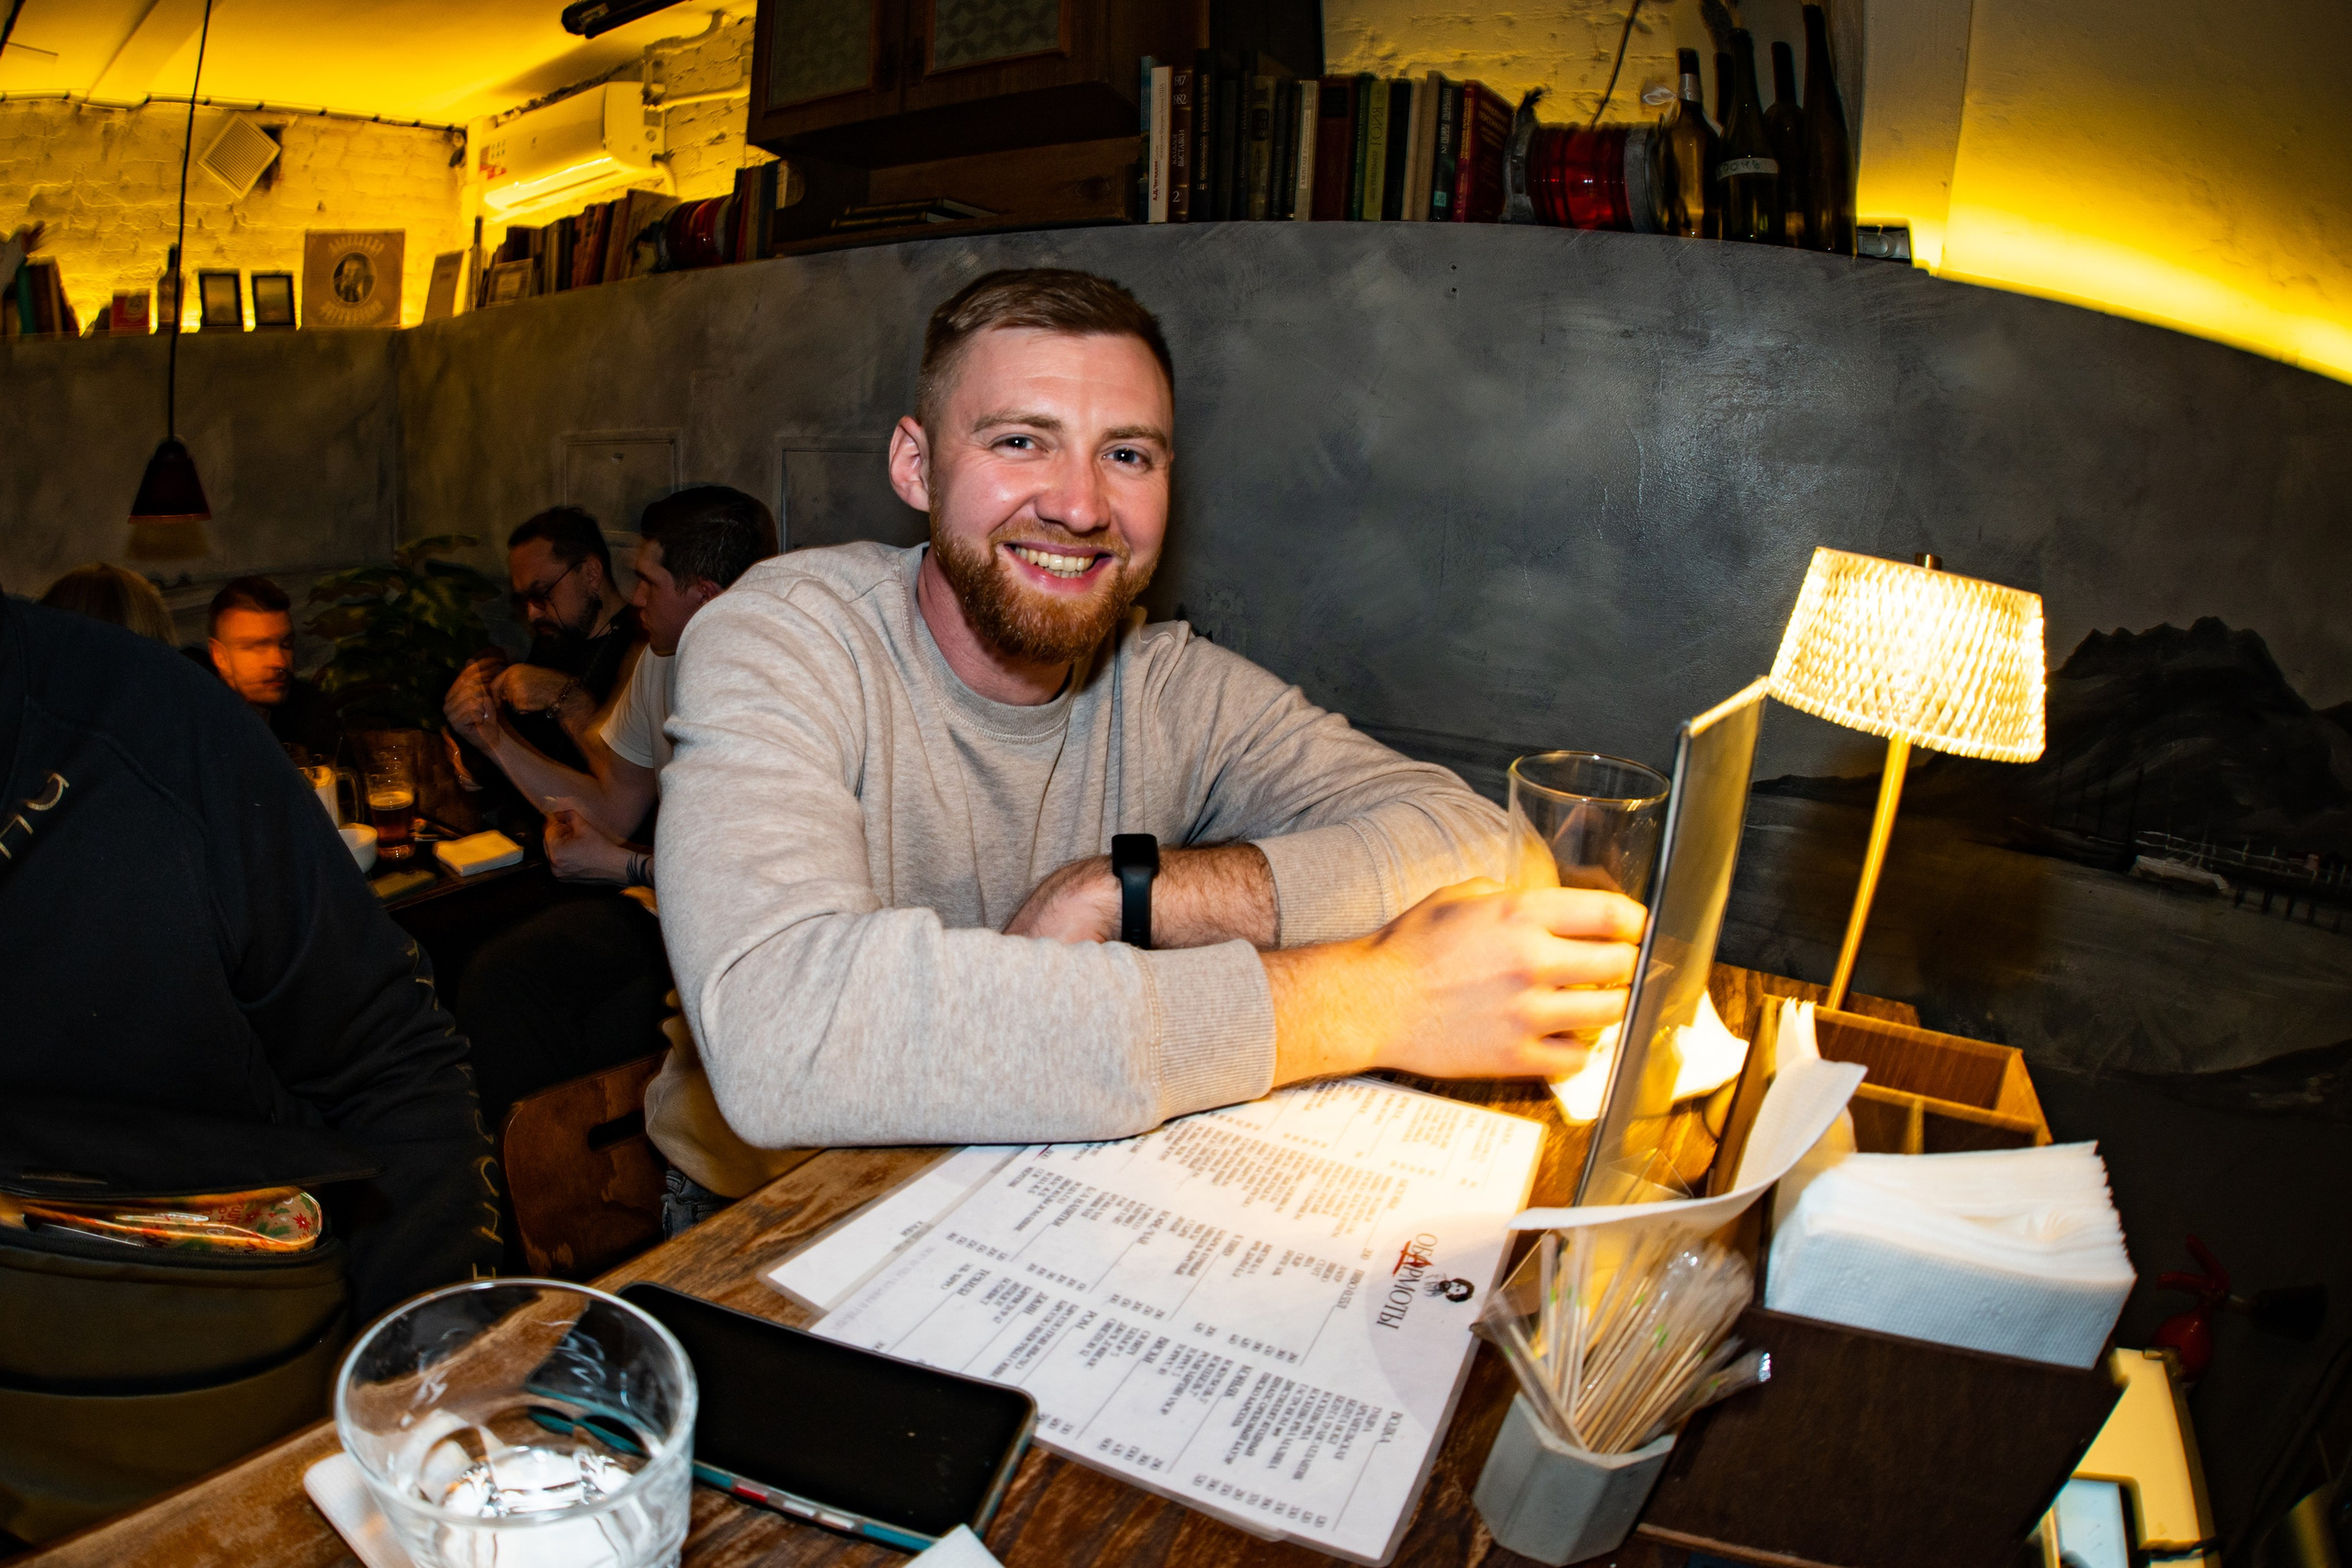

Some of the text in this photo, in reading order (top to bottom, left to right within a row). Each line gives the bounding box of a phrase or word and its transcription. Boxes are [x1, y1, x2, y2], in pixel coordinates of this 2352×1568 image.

[1174, 75, 1186, 87] 1917
[1173, 94, 1187, 105] 1982
[1370, 107, 1383, 146] ГОЙЯ
[1172, 191, 1180, 202] 2
